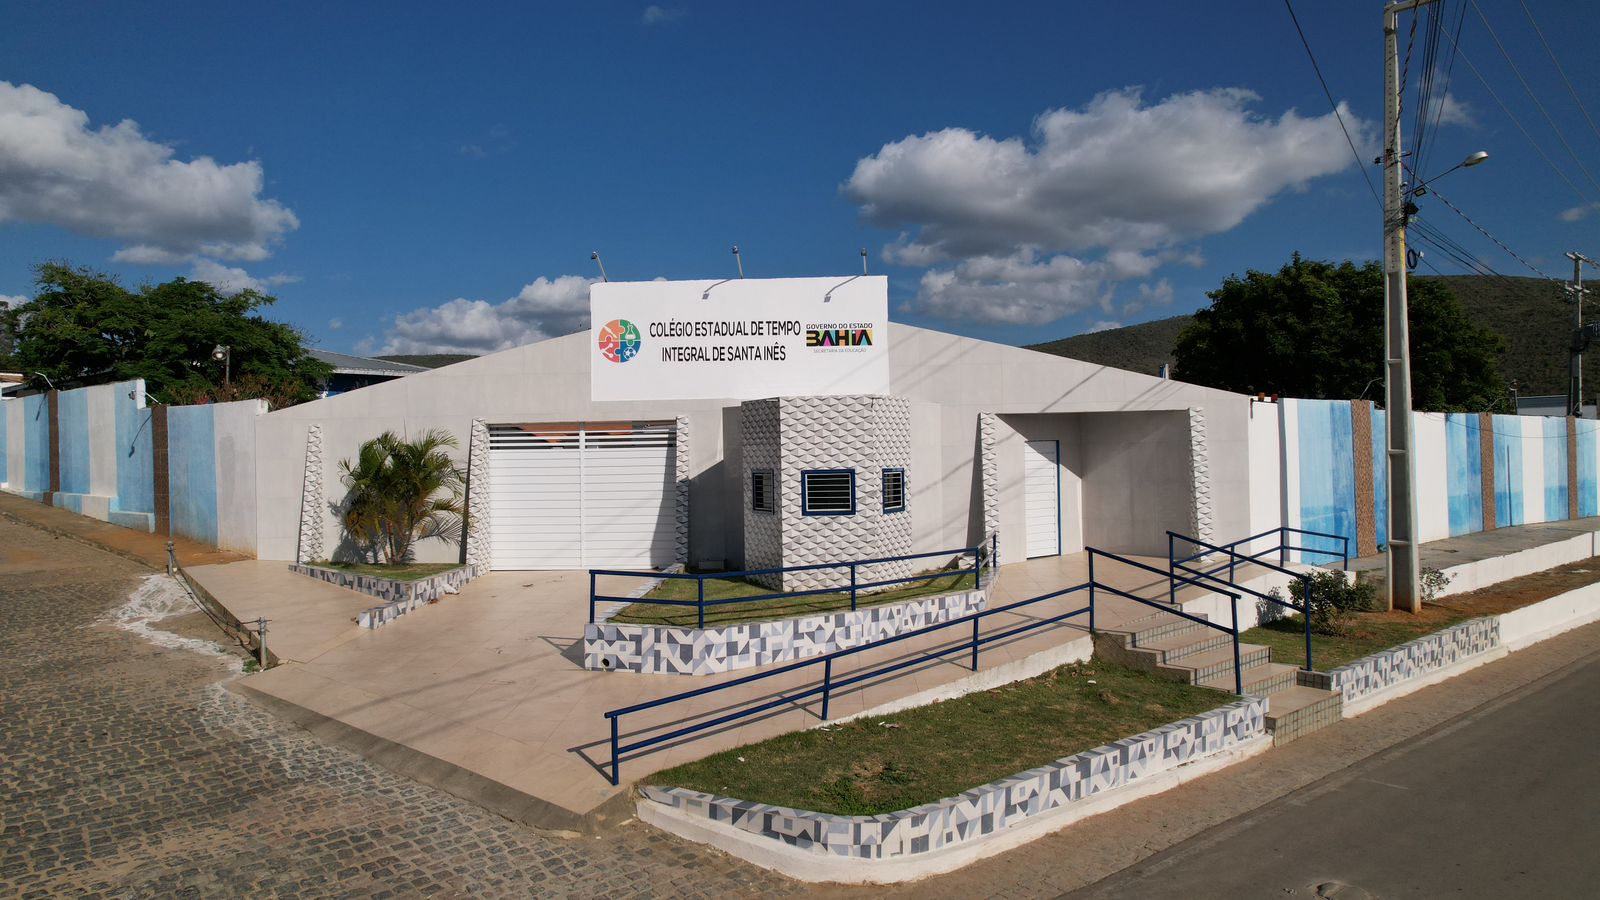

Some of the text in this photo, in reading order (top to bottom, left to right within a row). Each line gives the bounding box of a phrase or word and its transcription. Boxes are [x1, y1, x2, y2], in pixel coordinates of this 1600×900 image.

[649, 318, 802, 338] COLÉGIO ESTADUAL DE TEMPO
[661, 342, 787, 362] INTEGRAL DE SANTA INÊS
